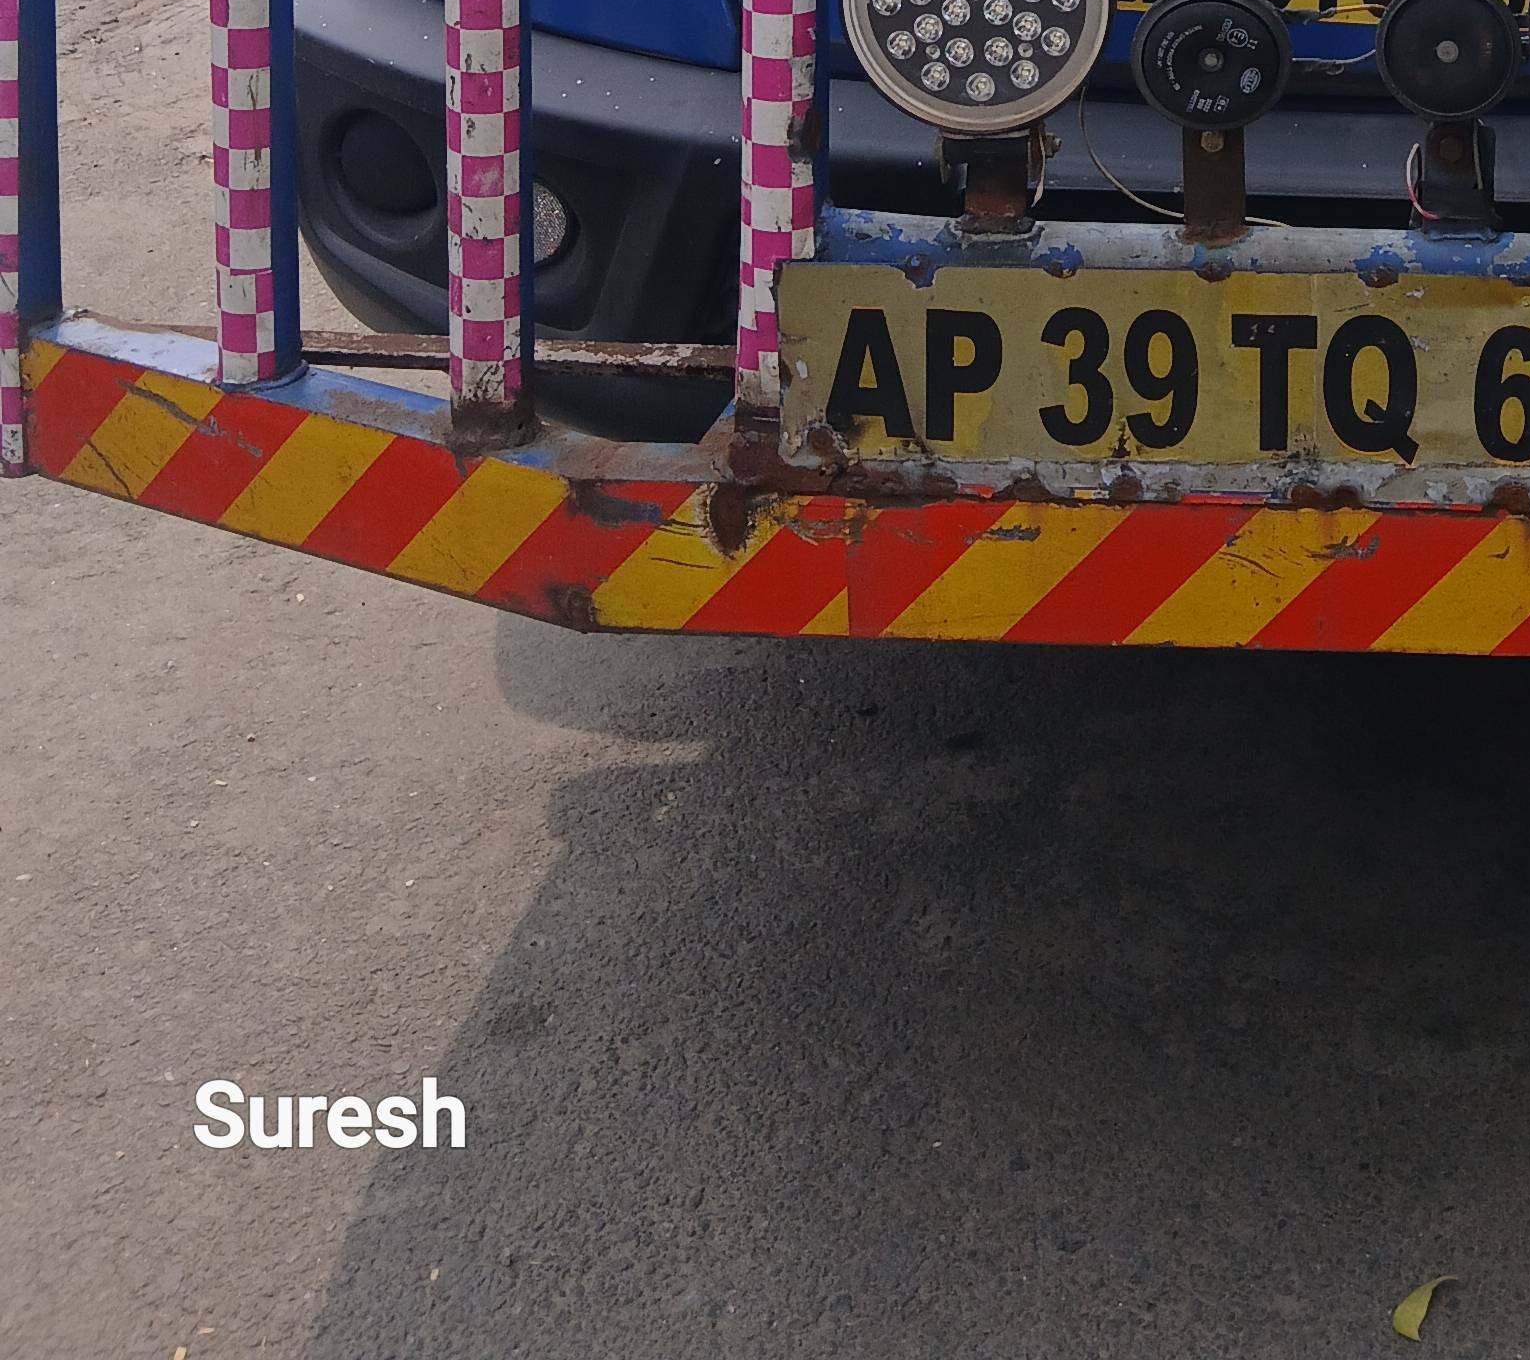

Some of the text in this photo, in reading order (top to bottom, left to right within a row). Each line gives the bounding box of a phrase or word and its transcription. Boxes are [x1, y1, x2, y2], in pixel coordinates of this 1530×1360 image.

[824, 307, 1002, 440] AP
[1038, 306, 1200, 449] 39
[1230, 314, 1420, 464] TQ
